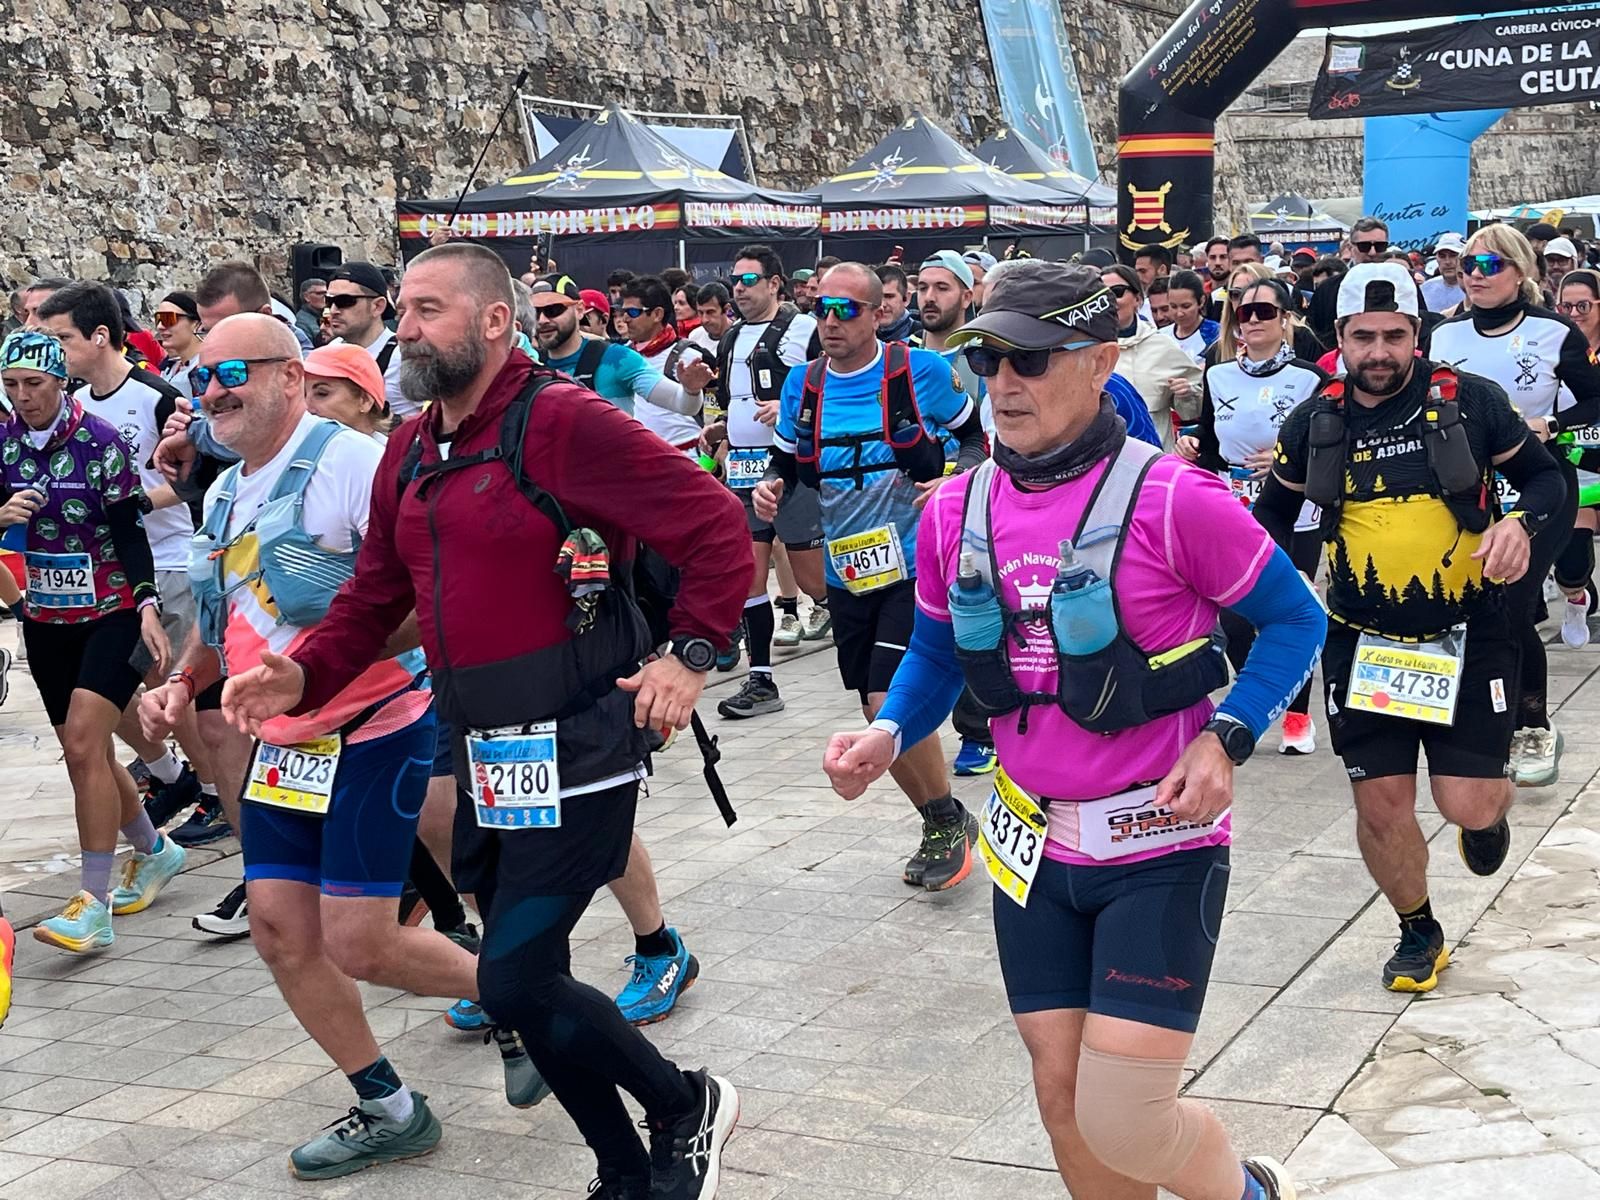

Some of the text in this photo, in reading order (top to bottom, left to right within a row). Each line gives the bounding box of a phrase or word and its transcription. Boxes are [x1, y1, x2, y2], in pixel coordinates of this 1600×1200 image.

[1187, 17, 1201, 38] del
[1495, 23, 1548, 36] CARRERA
[1522, 43, 1553, 64] DE
[1561, 39, 1593, 60] LA
[419, 204, 655, 238] CLUB DEPORTIVO
[829, 206, 966, 232] DEPORTIVO
[1430, 205, 1450, 217] es
[1056, 294, 1110, 327] VAIRO
[740, 460, 765, 473] 1823
[1353, 450, 1372, 463] DE
[853, 545, 890, 571] 4617
[43, 569, 88, 588] 1942
[1363, 651, 1375, 661] X
[1390, 671, 1450, 700] 4738
[279, 751, 332, 784] 4023
[491, 763, 549, 795] 2180
[991, 804, 1037, 866] 4313
[657, 962, 679, 994] HOKA
